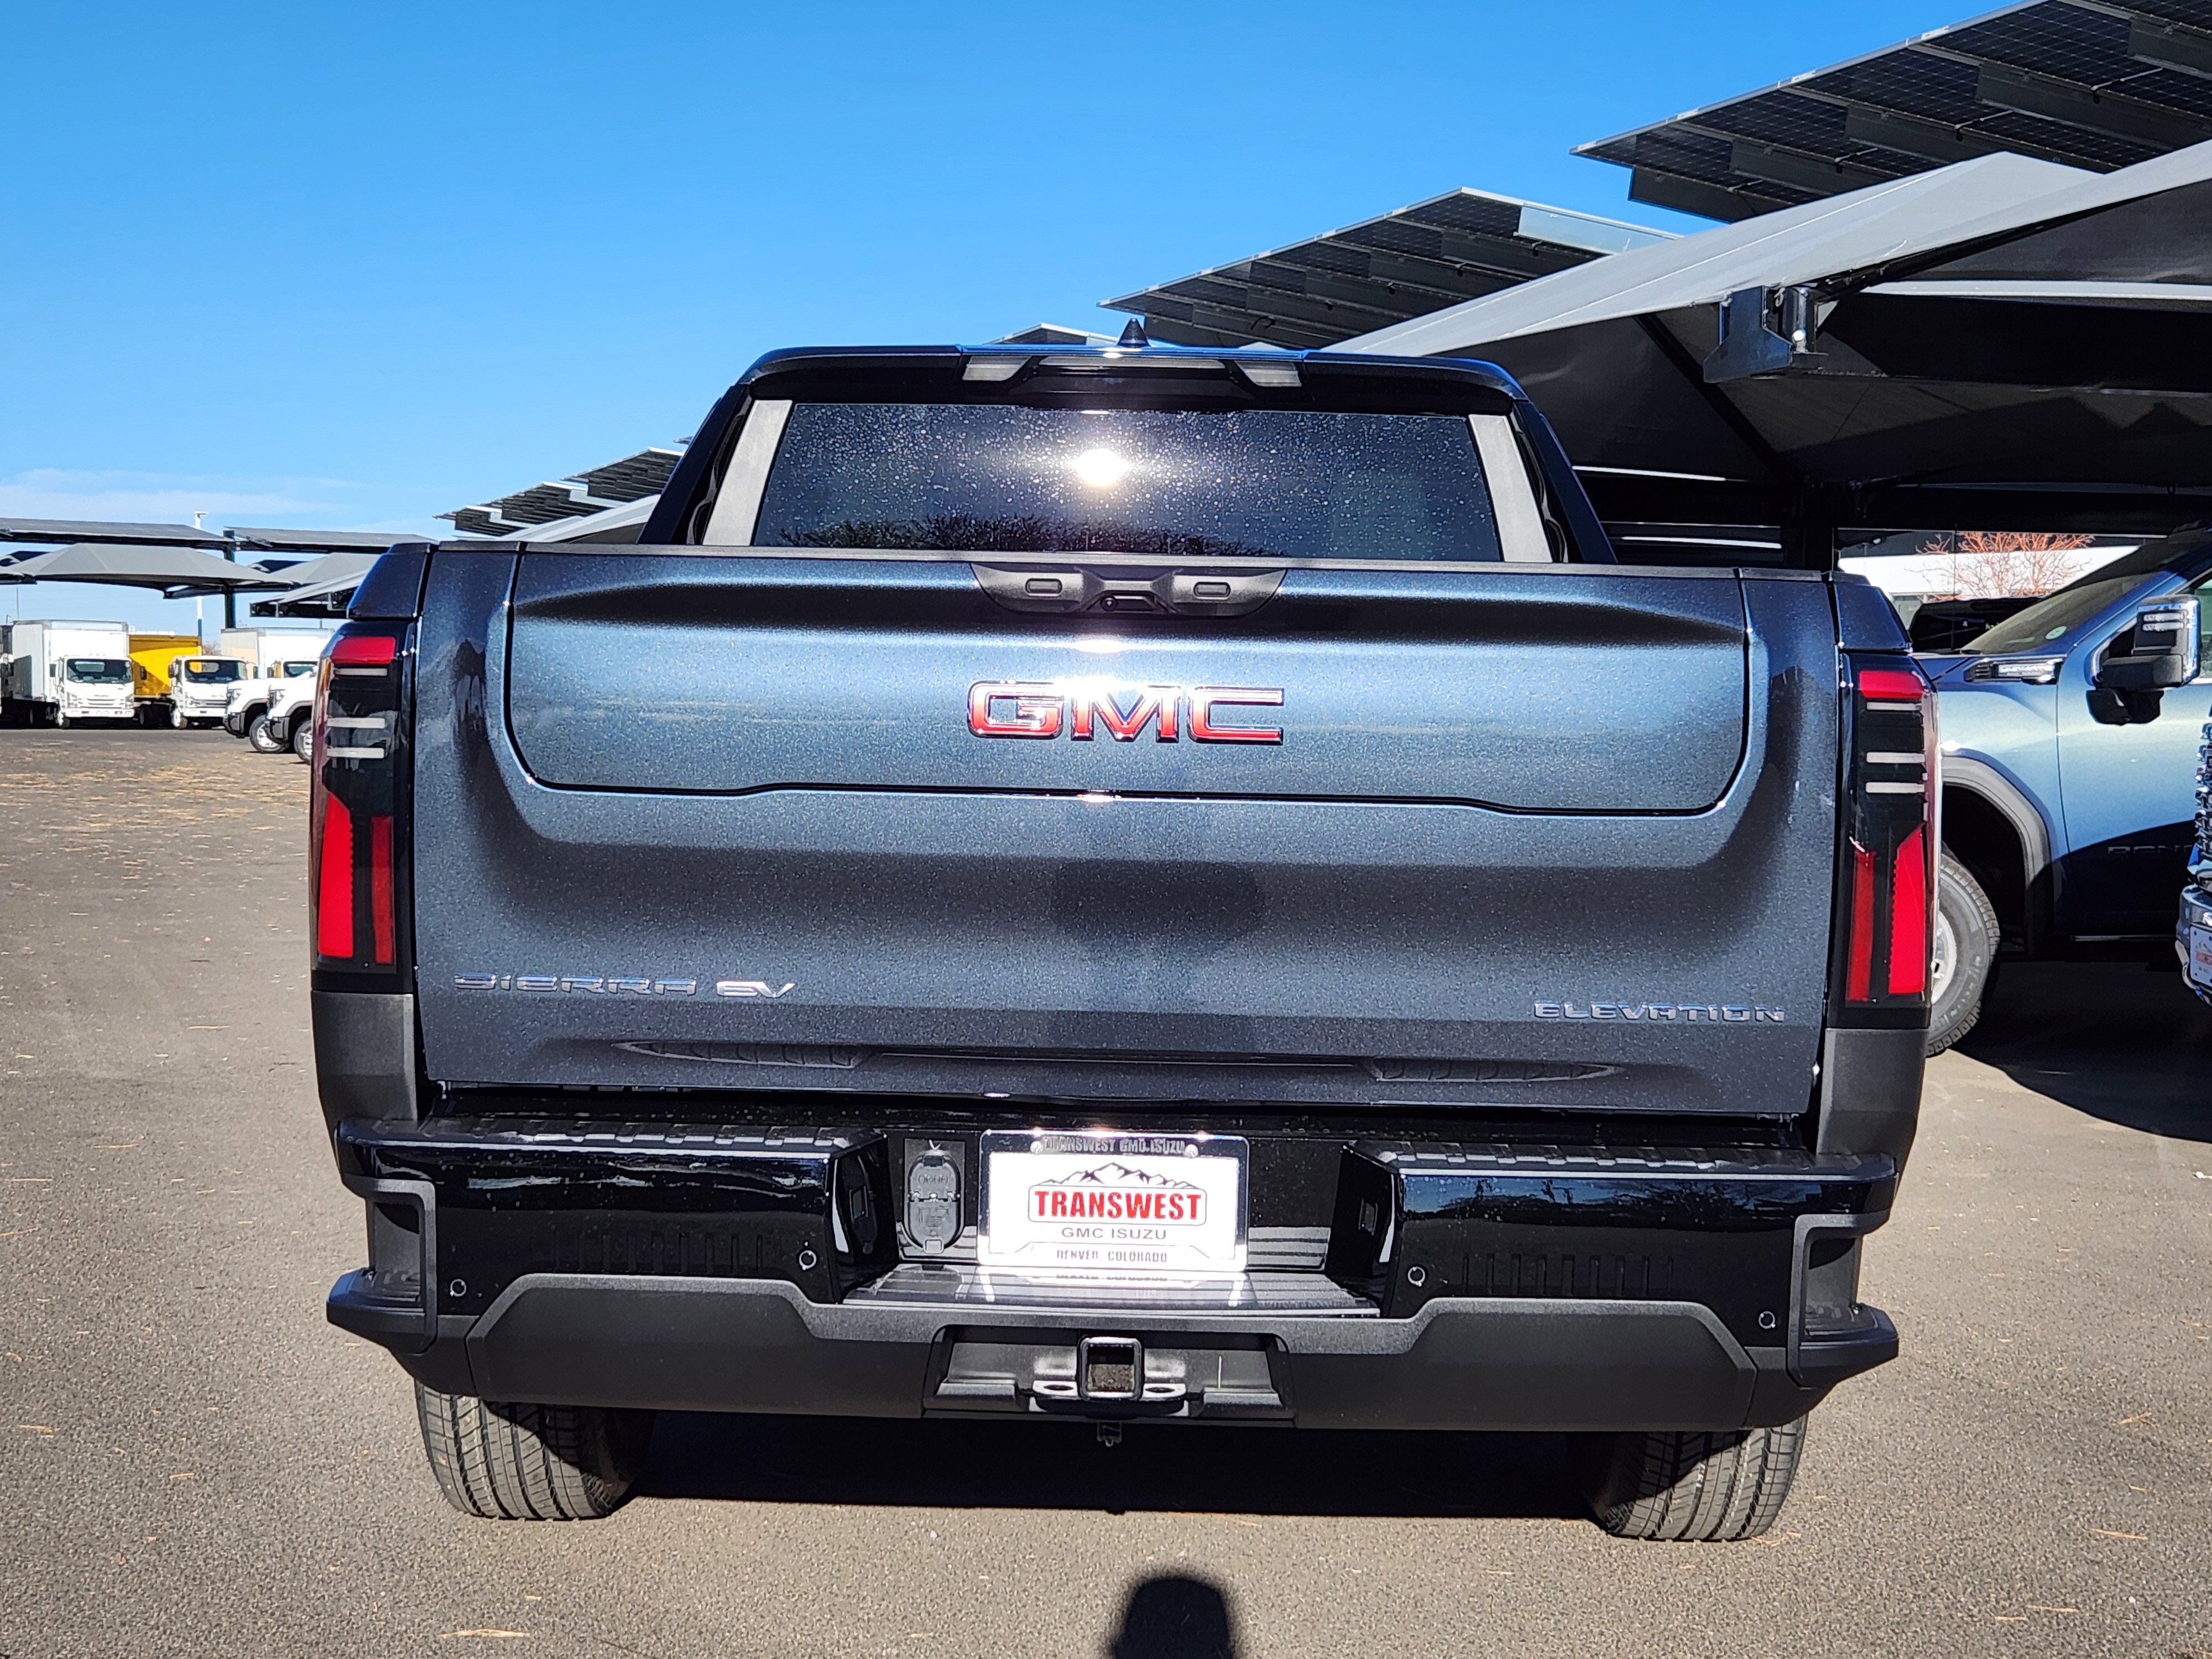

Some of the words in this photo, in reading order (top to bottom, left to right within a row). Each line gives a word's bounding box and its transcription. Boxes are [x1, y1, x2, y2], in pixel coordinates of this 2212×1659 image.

[967, 681, 1285, 745] GMC
[453, 972, 697, 995] SIERRA
[716, 980, 795, 998] EV
[1534, 1000, 1786, 1022] ELEVATION
[1035, 1190, 1201, 1220] TRANSWEST
[1061, 1227, 1104, 1239] GMC
[1112, 1228, 1167, 1240] ISUZU
[1108, 1250, 1167, 1263] COLORADO
